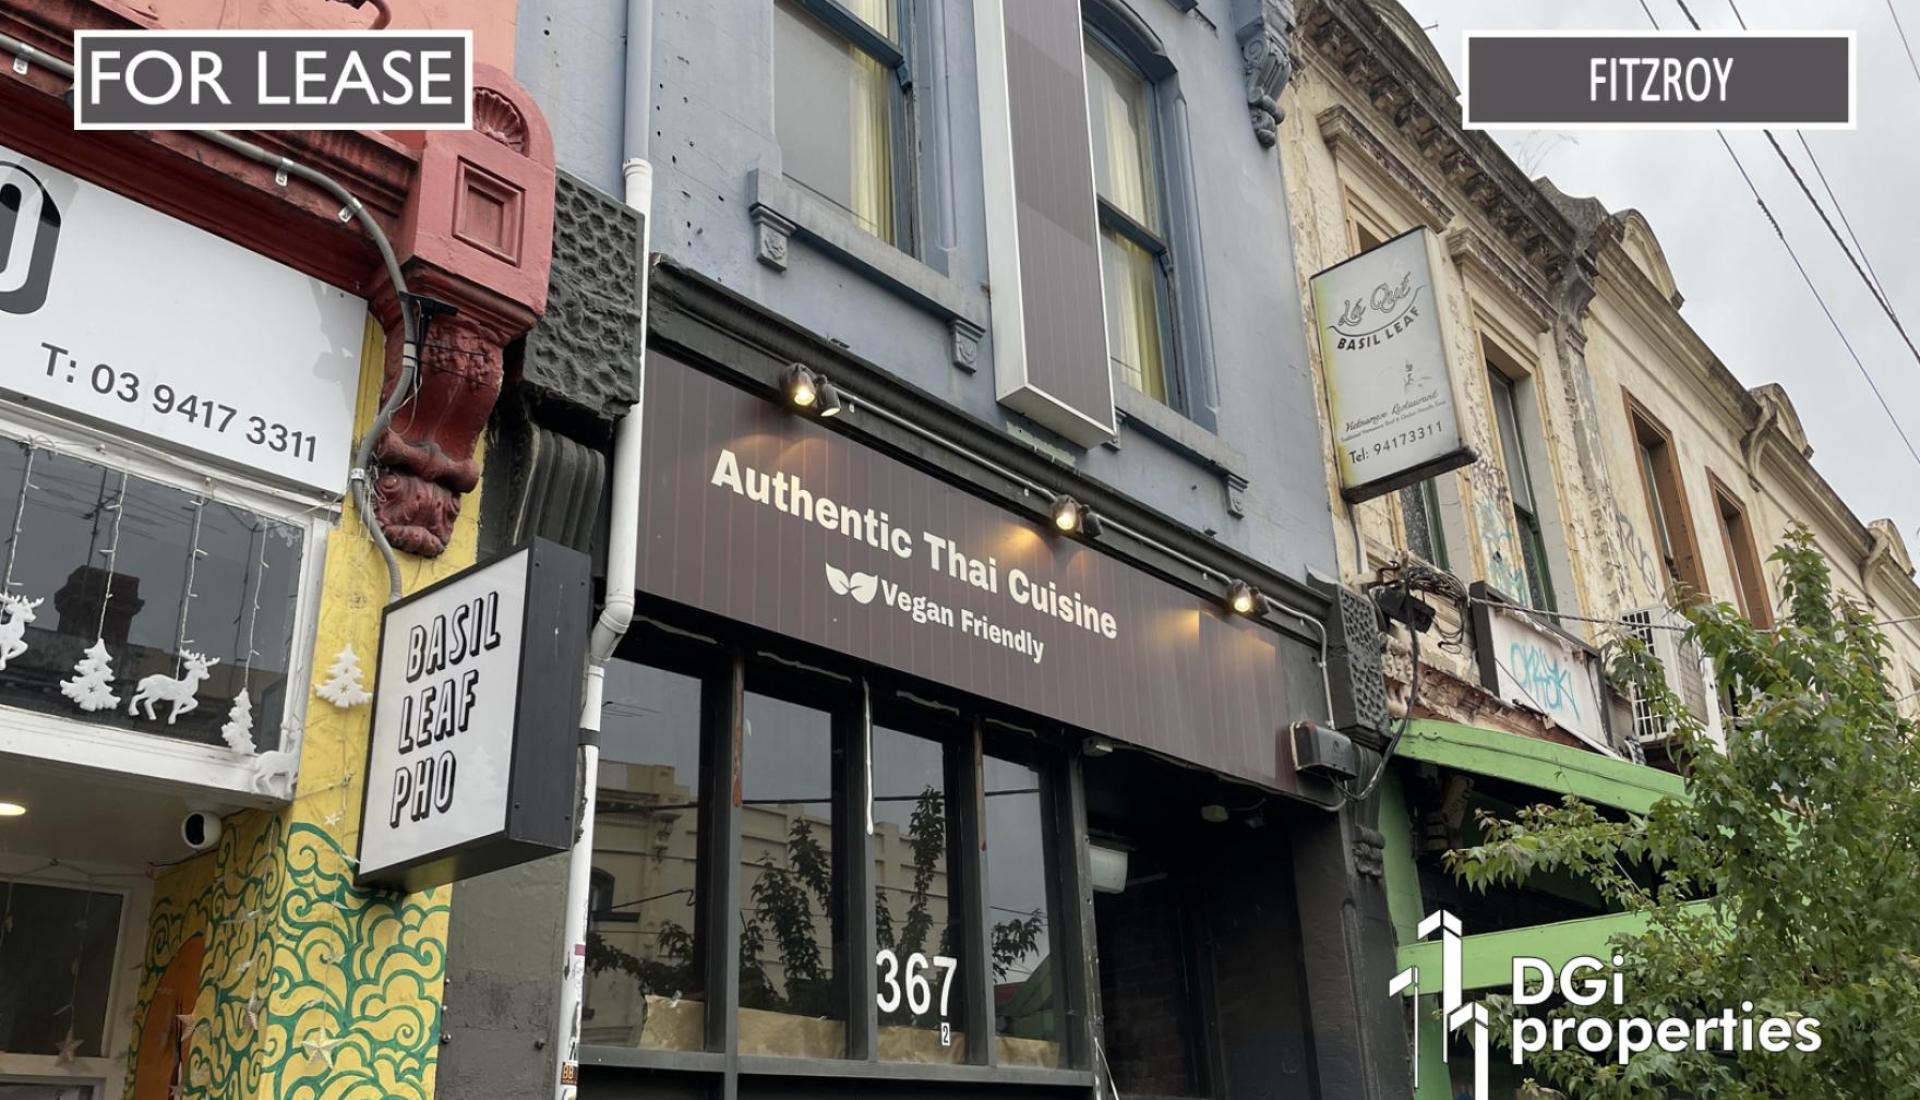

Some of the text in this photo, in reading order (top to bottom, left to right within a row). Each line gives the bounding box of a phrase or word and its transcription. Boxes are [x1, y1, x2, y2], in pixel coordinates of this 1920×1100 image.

[1337, 306, 1419, 351] BASIL LEAF
[41, 342, 317, 462] T: 03 9417 3311
[1348, 447, 1369, 464] Tel:
[1373, 420, 1442, 455] 94173311
[711, 448, 1118, 640] Authentic Thai Cuisine
[406, 591, 501, 683] BASIL
[881, 579, 1044, 664] Vegan Friendly
[398, 669, 479, 755] LEAF
[390, 750, 456, 829] PHO
[876, 948, 958, 1017] 367
